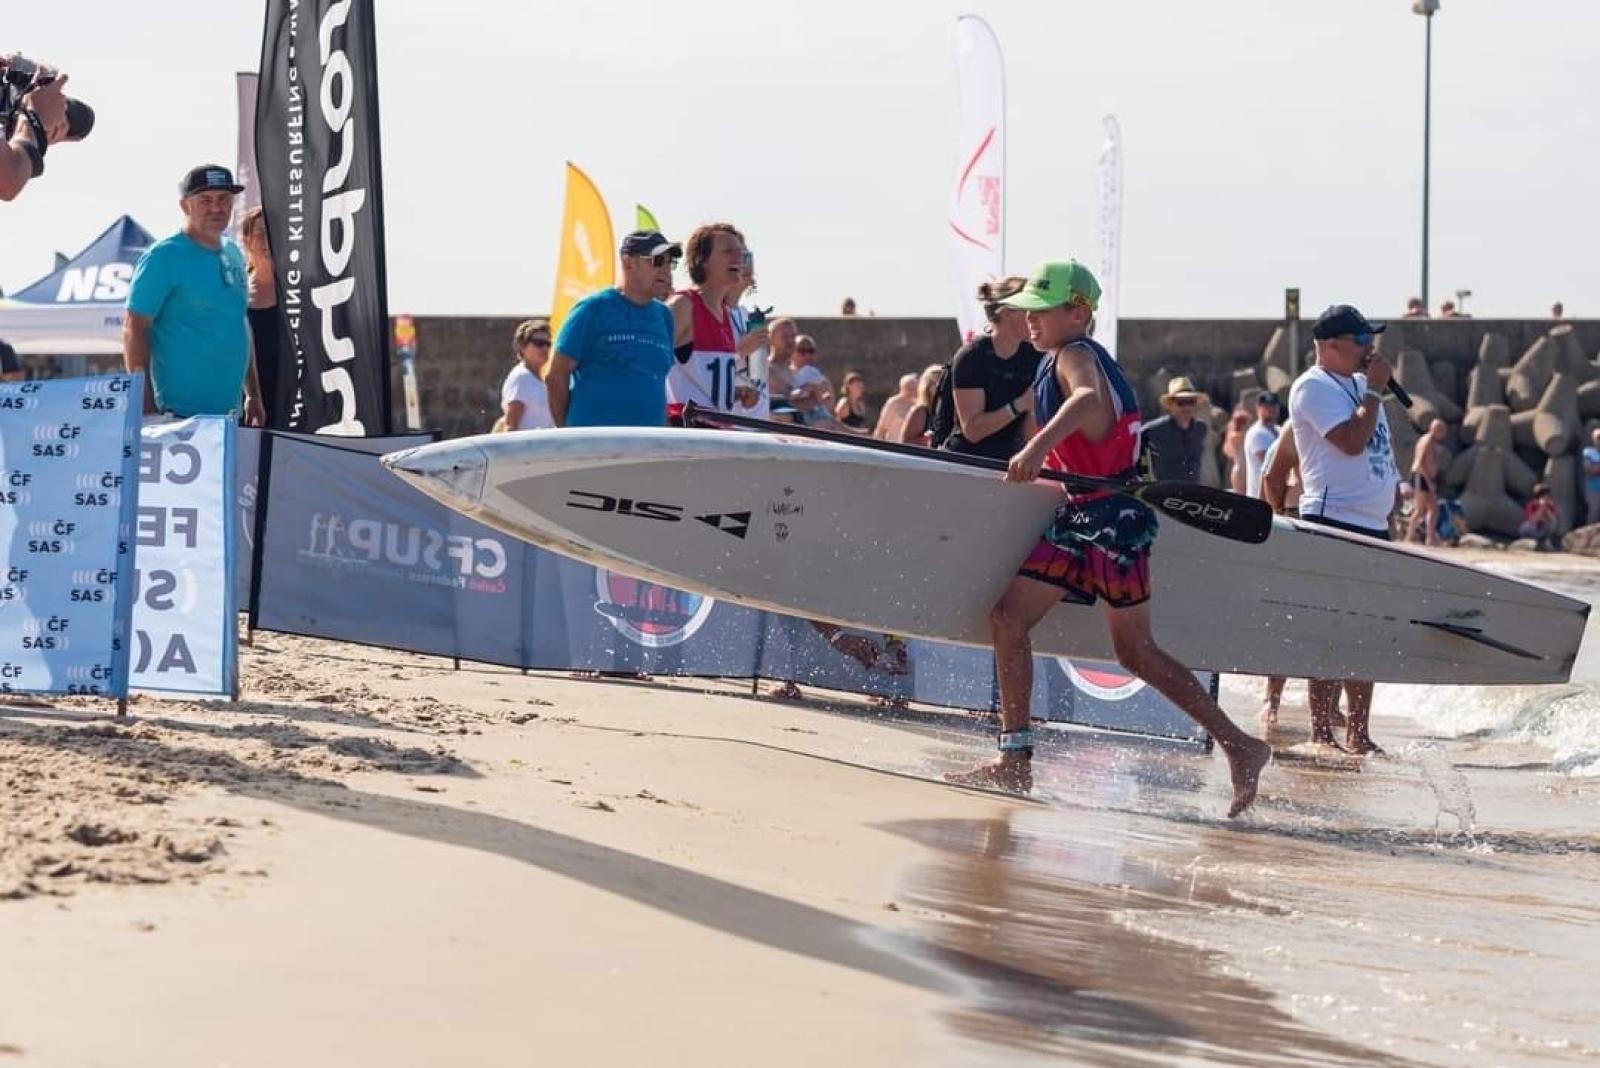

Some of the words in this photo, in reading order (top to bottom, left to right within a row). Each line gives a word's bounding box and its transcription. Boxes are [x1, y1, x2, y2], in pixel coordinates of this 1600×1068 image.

[109, 377, 132, 392] ČF
[82, 397, 115, 410] SAS
[58, 423, 81, 439] ČF
[32, 444, 66, 457] SAS
[9, 470, 32, 486] ČF
[101, 471, 125, 488] ČF
[74, 493, 108, 506] SAS
[566, 489, 684, 522] SIC
[53, 519, 76, 535] ČF
[28, 540, 61, 553] SAS
[7, 567, 29, 583] ČF
[96, 568, 119, 584] ČF
[70, 589, 104, 602] SAS
[47, 615, 70, 632] ČF
[23, 636, 56, 649] SAS
[1, 662, 23, 678] ČF
[91, 664, 114, 680] ČF
